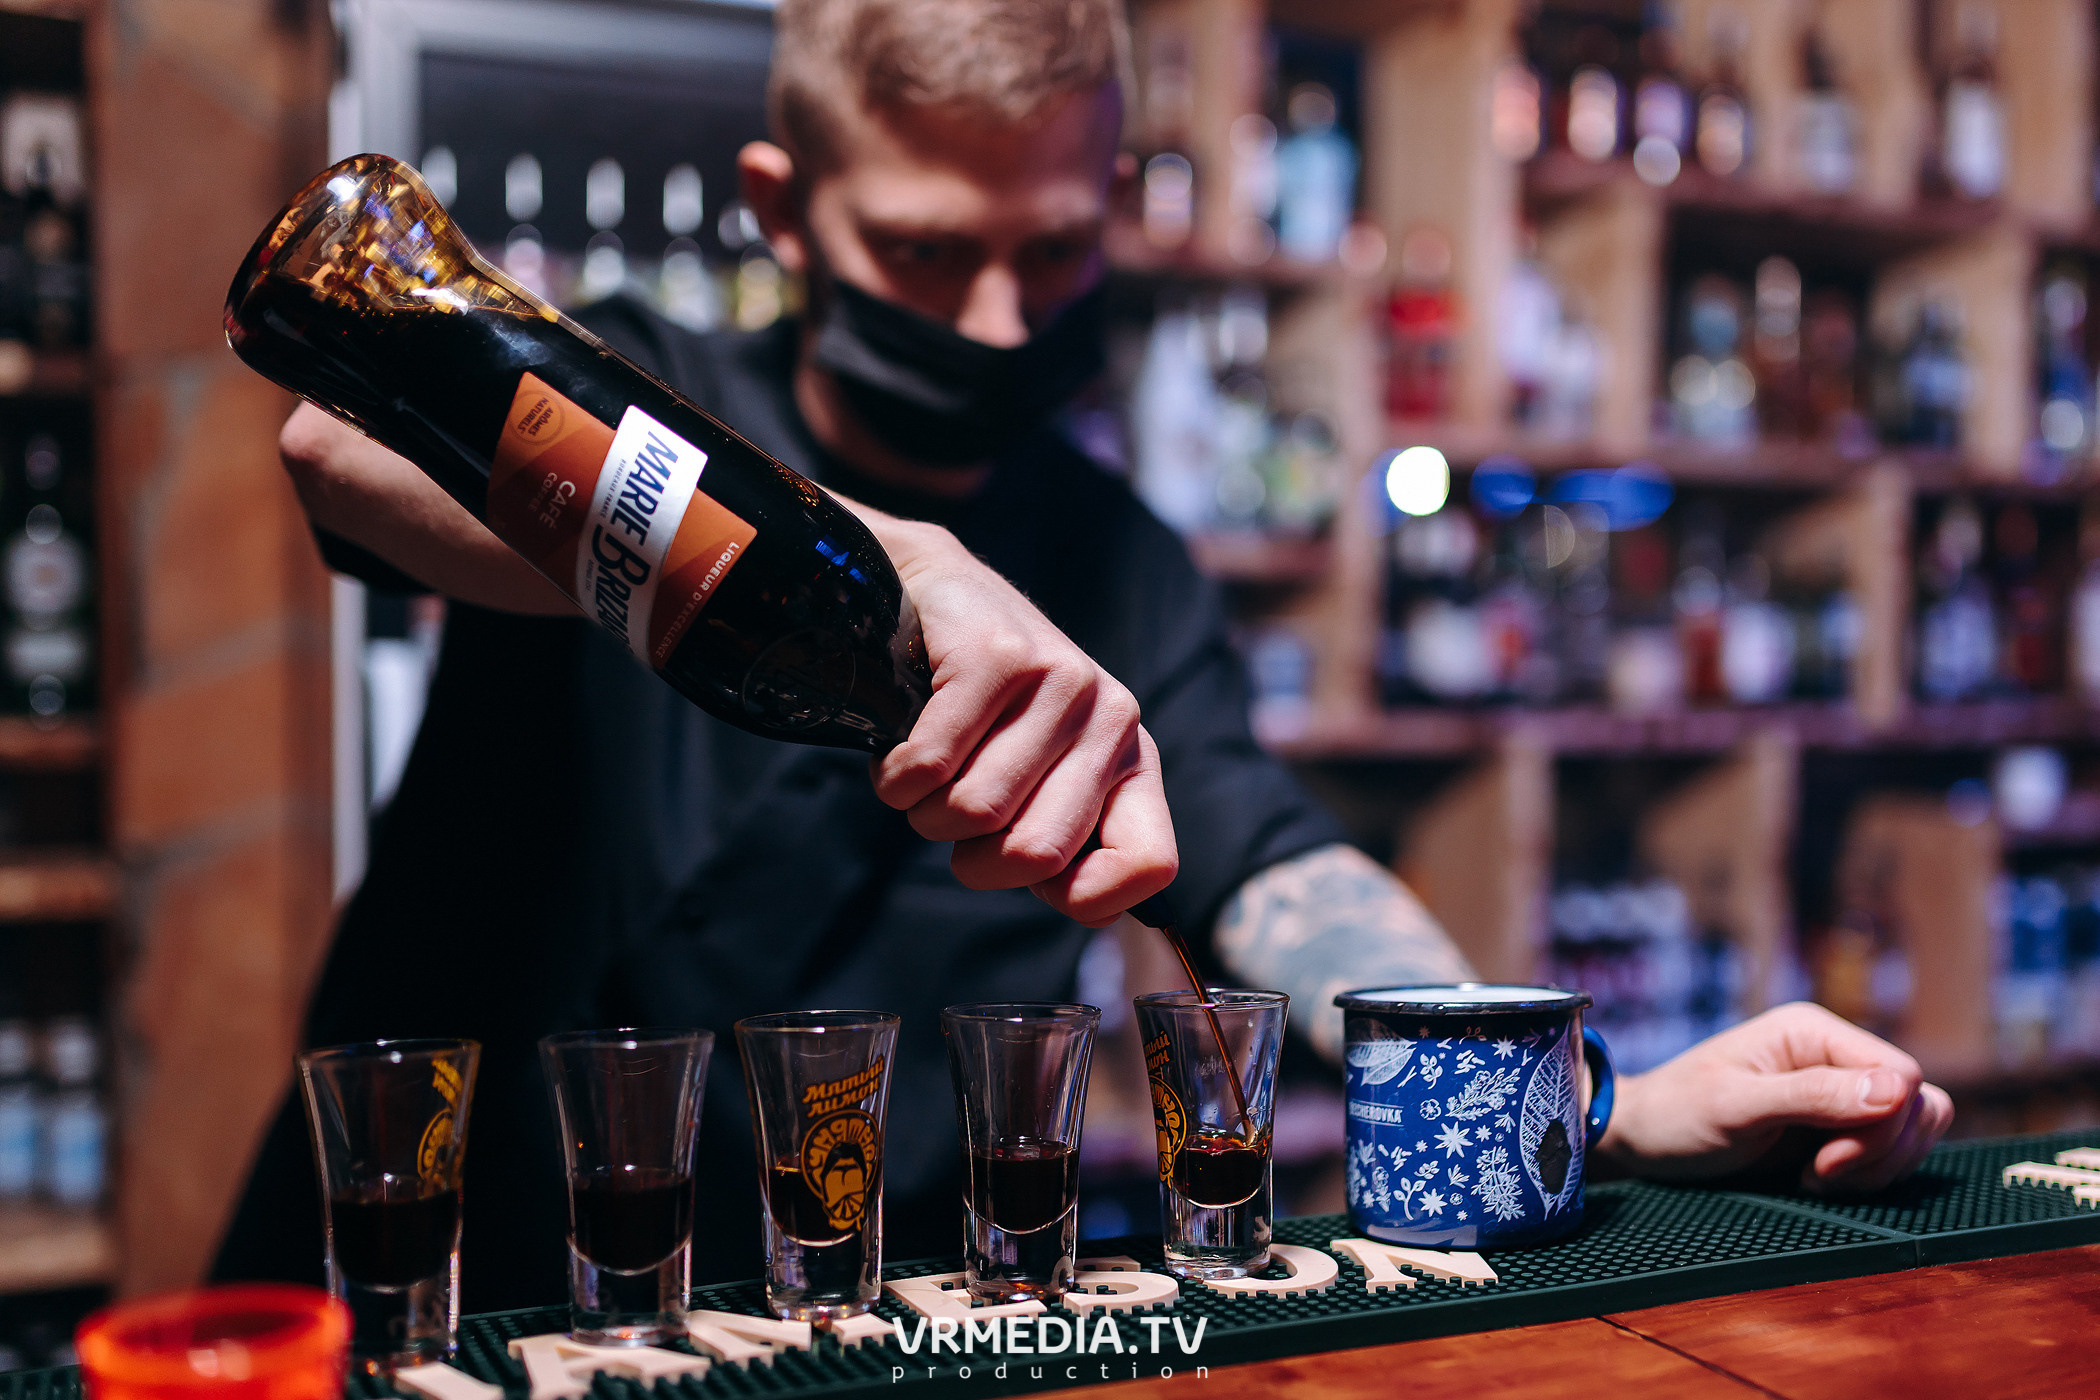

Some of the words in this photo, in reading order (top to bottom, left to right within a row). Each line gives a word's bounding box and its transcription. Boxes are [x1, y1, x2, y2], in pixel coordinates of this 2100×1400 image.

[609, 431, 680, 546] MARIE
[700, 541, 740, 591] LIQUEUR
[655, 591, 703, 659] D'EXCELLENCE
